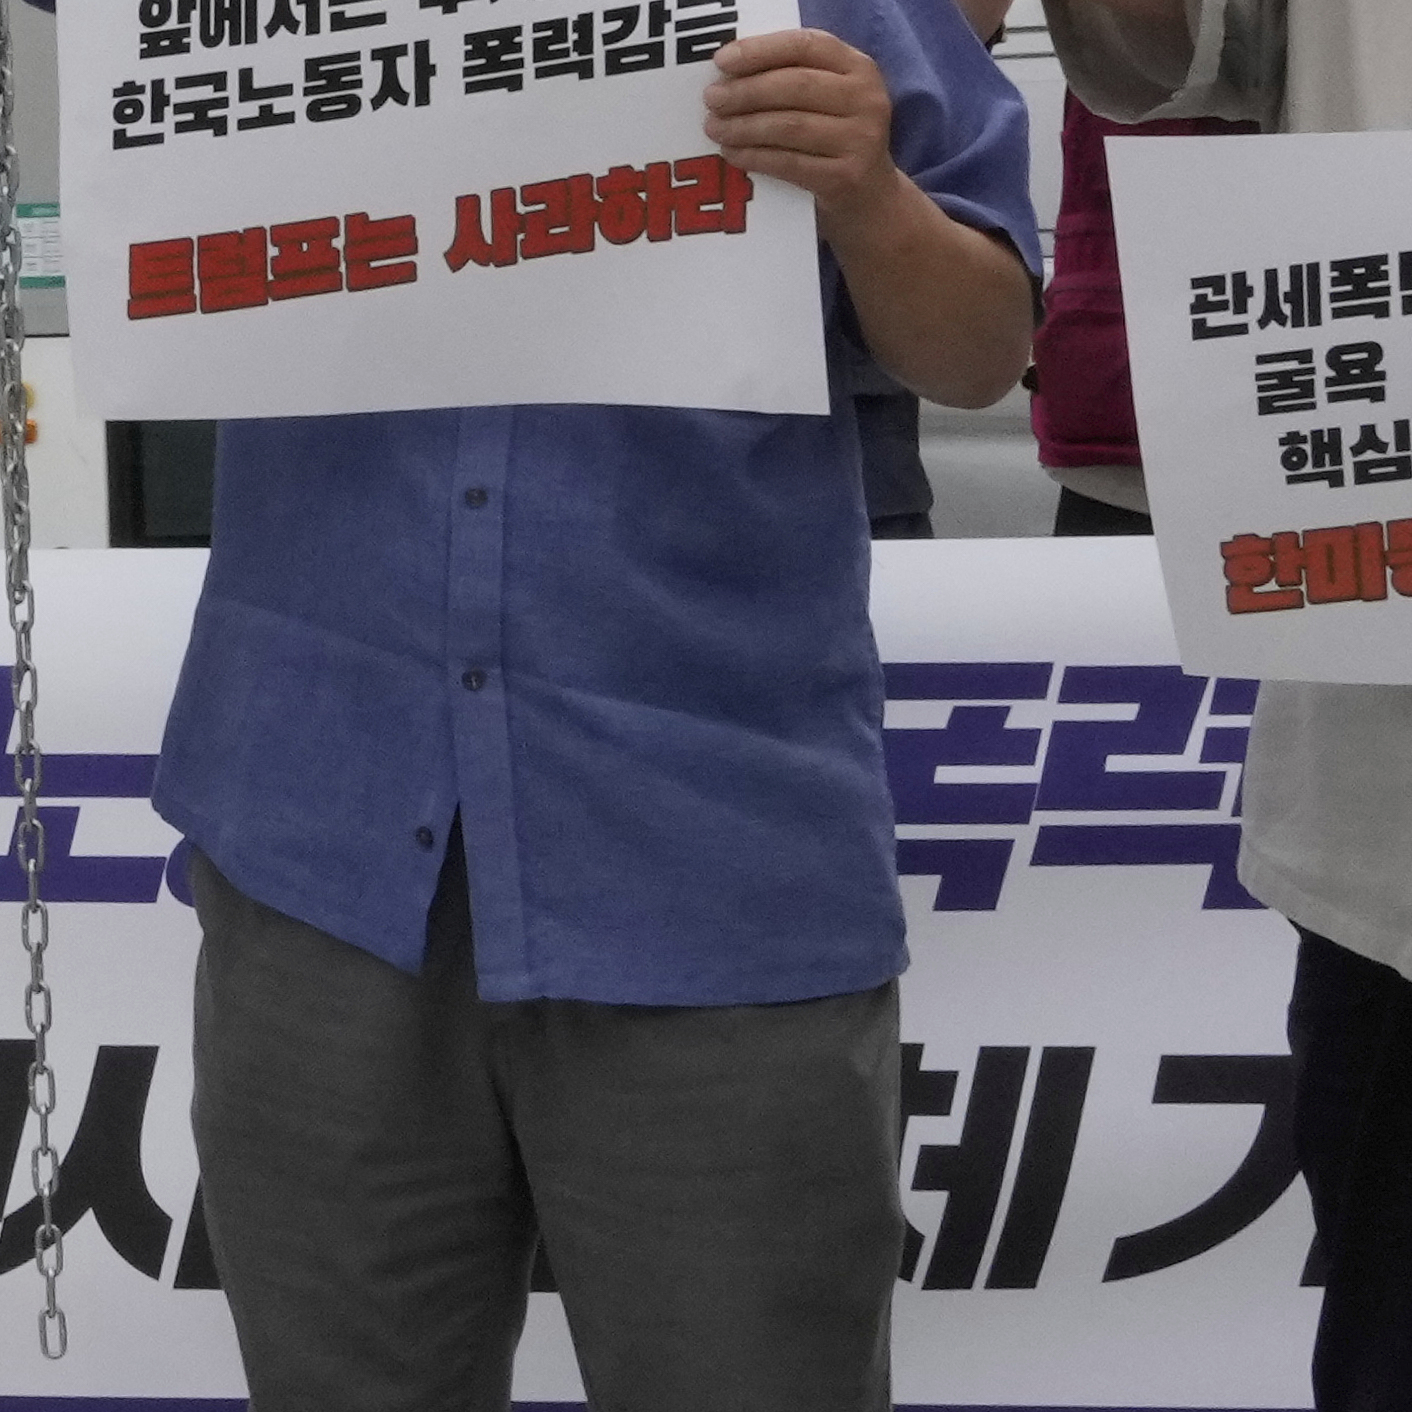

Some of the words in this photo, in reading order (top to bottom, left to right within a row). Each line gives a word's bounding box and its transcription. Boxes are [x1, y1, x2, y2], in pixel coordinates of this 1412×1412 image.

[113, 27, 436, 150] 한국노동자
[129, 214, 415, 317] 트럼프는
[447, 156, 751, 267] 사과하라
[1190, 251, 1412, 341] 관세폭
[1255, 341, 1386, 415] 굴욕
[1278, 419, 1412, 489] 핵심
